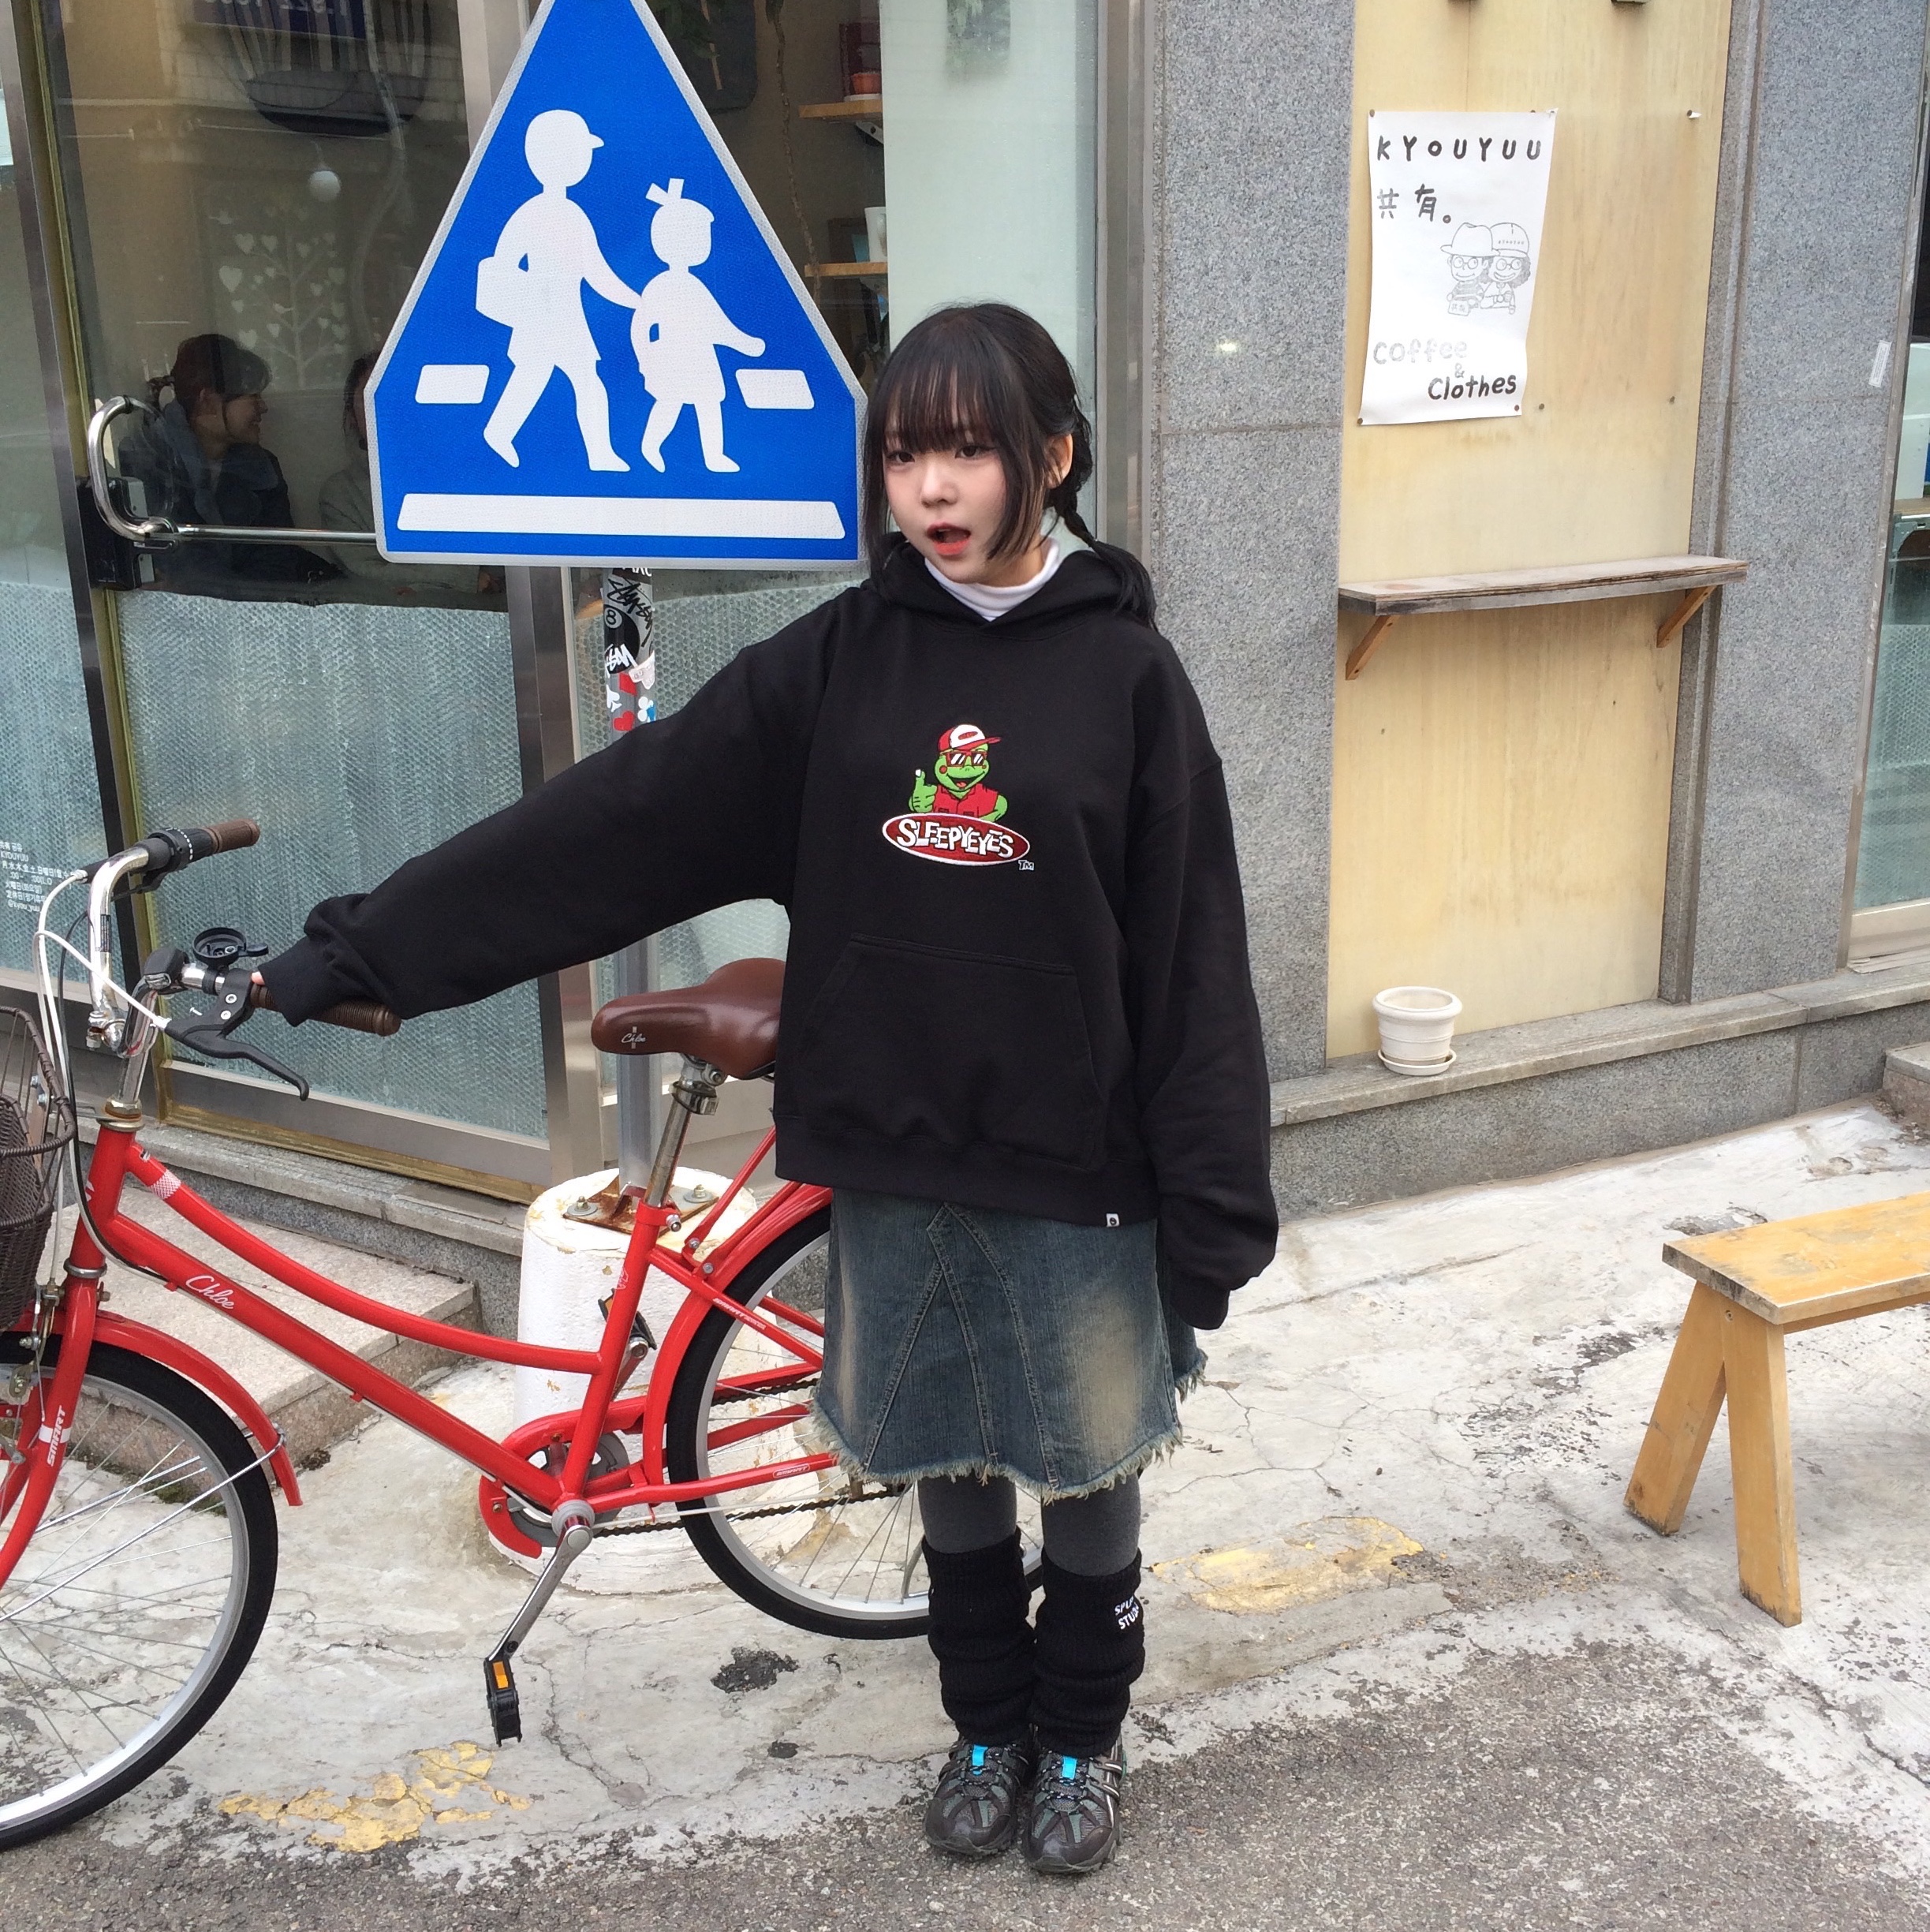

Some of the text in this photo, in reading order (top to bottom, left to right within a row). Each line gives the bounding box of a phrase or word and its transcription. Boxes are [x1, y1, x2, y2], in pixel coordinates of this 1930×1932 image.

[1377, 135, 1541, 162] KYOUYUU
[1454, 362, 1465, 379] &
[1428, 375, 1517, 400] Clothes
[605, 609, 617, 625] 8
[897, 818, 1014, 858] SLEEPYEYES
[1018, 860, 1035, 871] TM
[185, 1275, 235, 1310] Chloe
[47, 1404, 66, 1467] SMART
